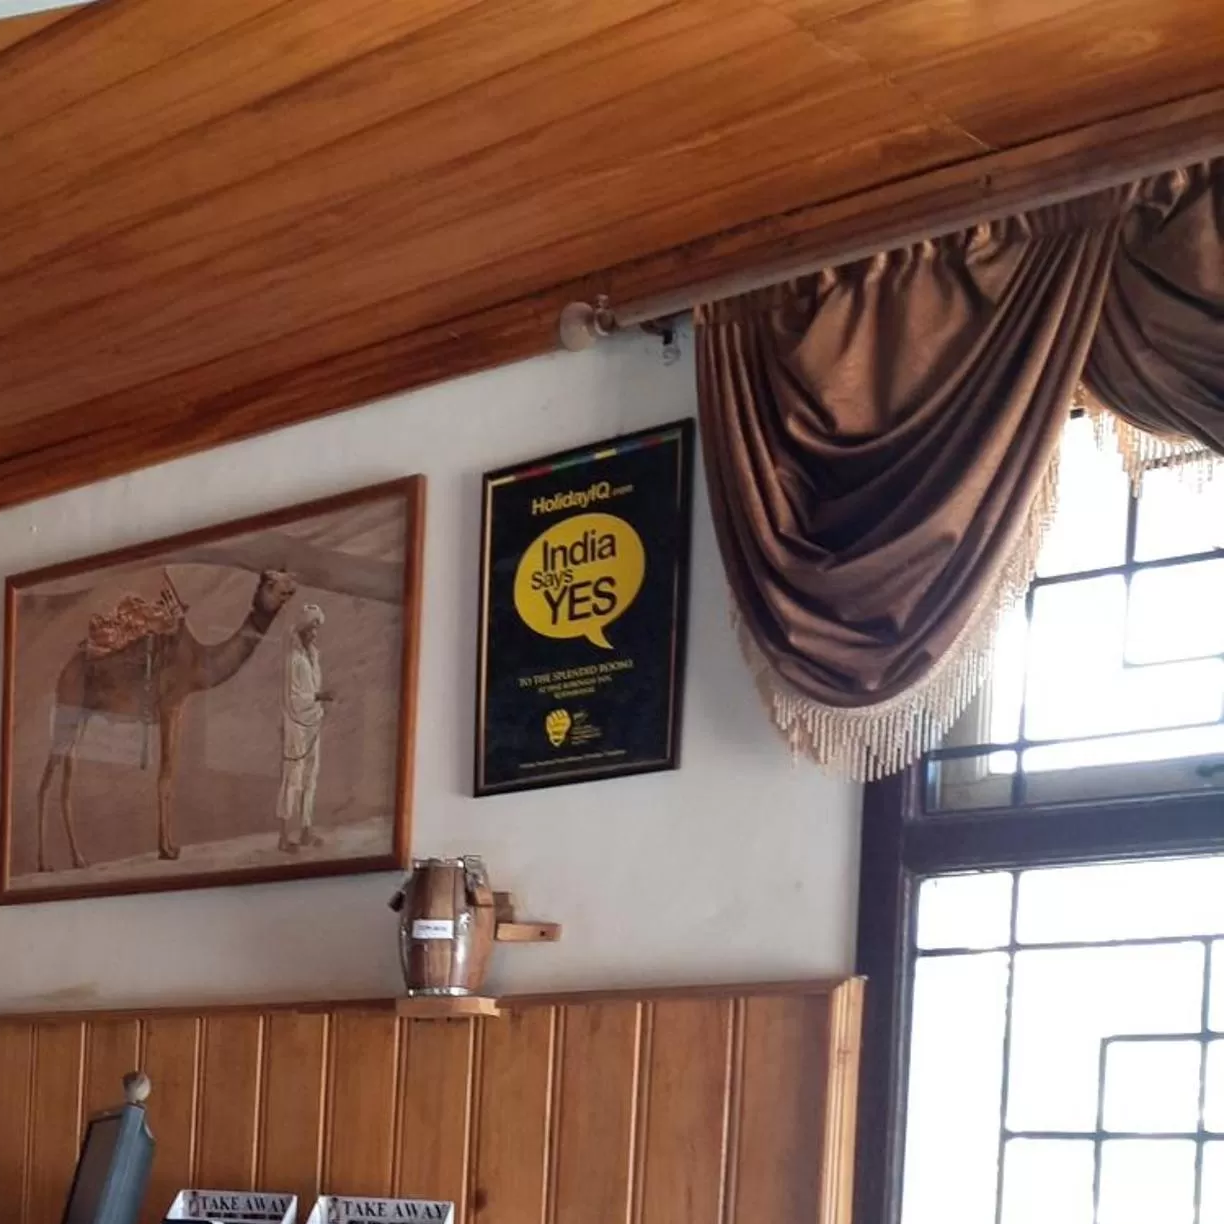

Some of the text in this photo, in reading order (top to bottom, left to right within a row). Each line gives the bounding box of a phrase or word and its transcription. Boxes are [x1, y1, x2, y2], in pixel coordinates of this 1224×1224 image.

[543, 529, 617, 571] India
[543, 576, 618, 625] YES
[199, 1196, 238, 1210] TAKE
[343, 1200, 446, 1219] TAKE AWAY
